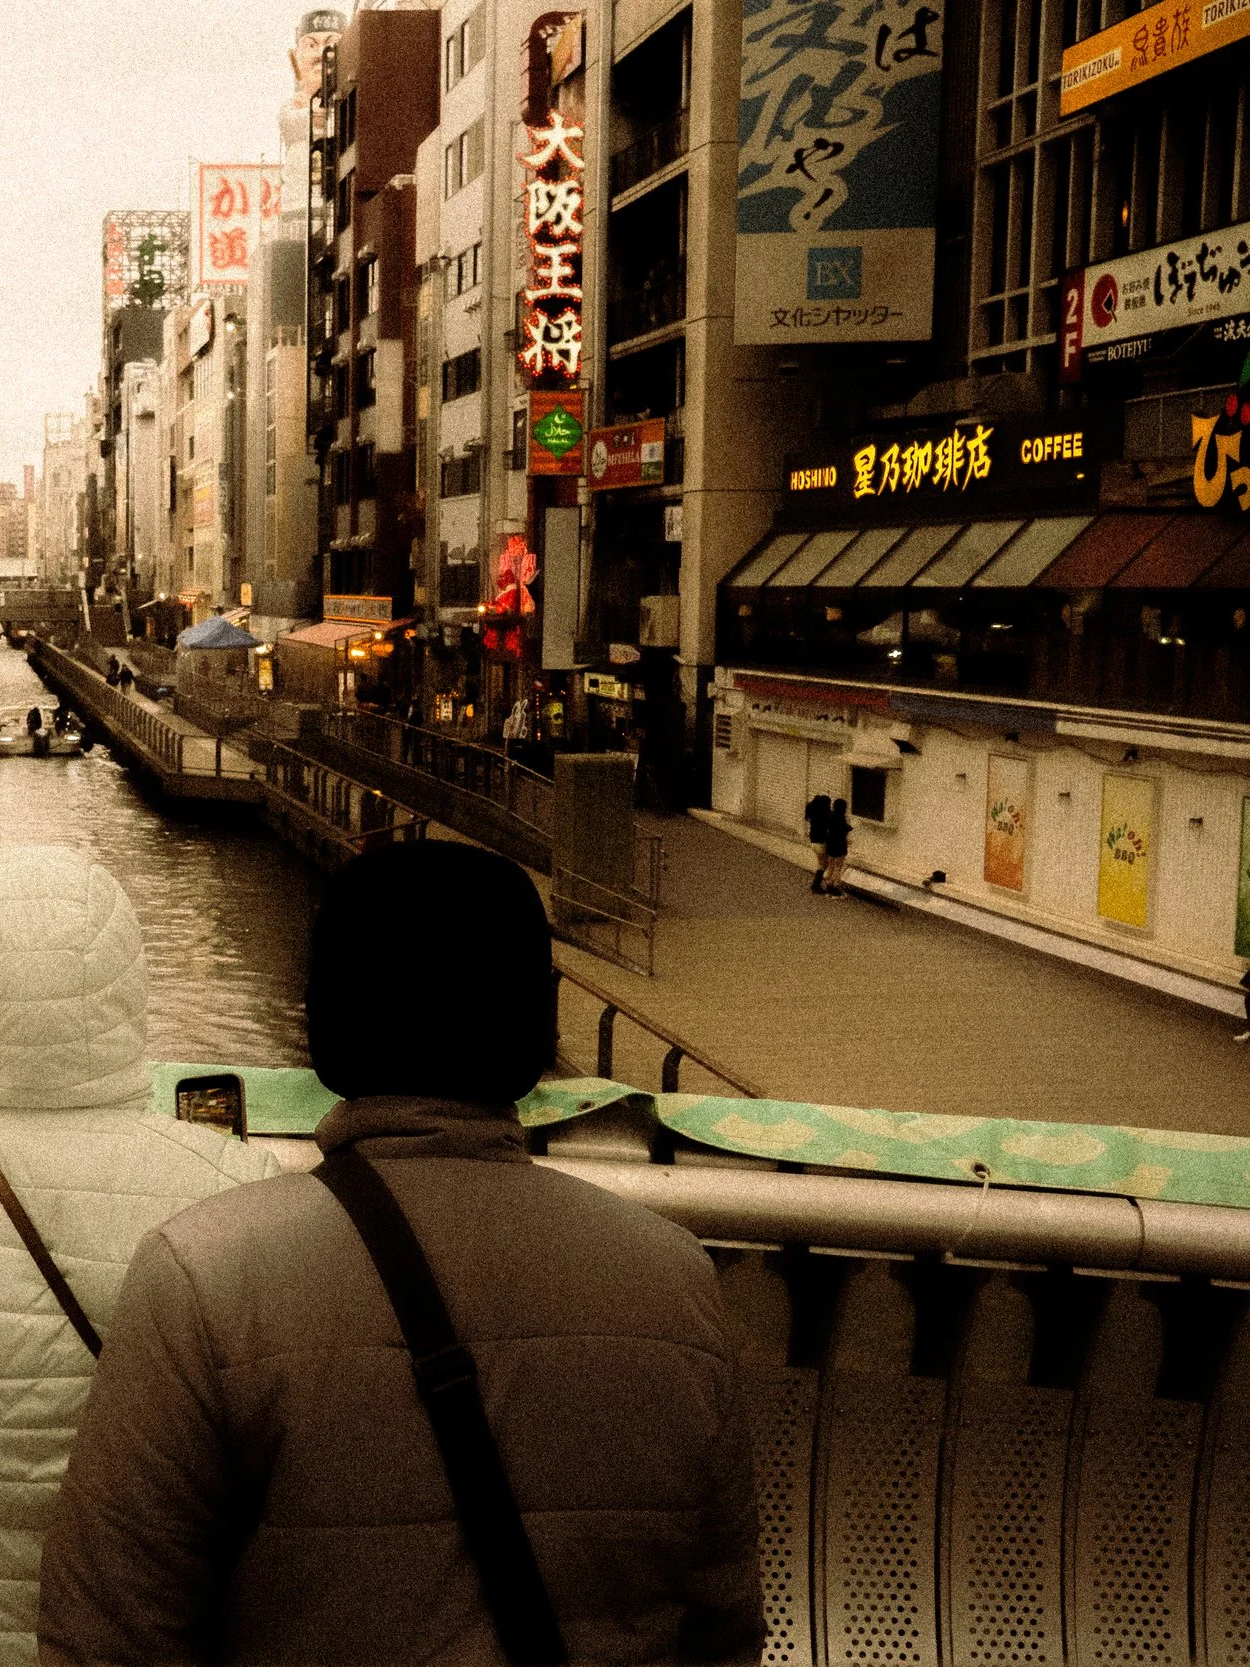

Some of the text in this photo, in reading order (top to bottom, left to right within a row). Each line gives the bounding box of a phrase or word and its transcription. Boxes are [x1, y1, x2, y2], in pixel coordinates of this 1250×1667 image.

[1062, 53, 1115, 89] TORIKIZOKU
[524, 113, 584, 374] 大阪王将
[790, 424, 1083, 499] HOSHINO 星乃珈琲店 COFFEE
[1114, 848, 1135, 865] BBQ
